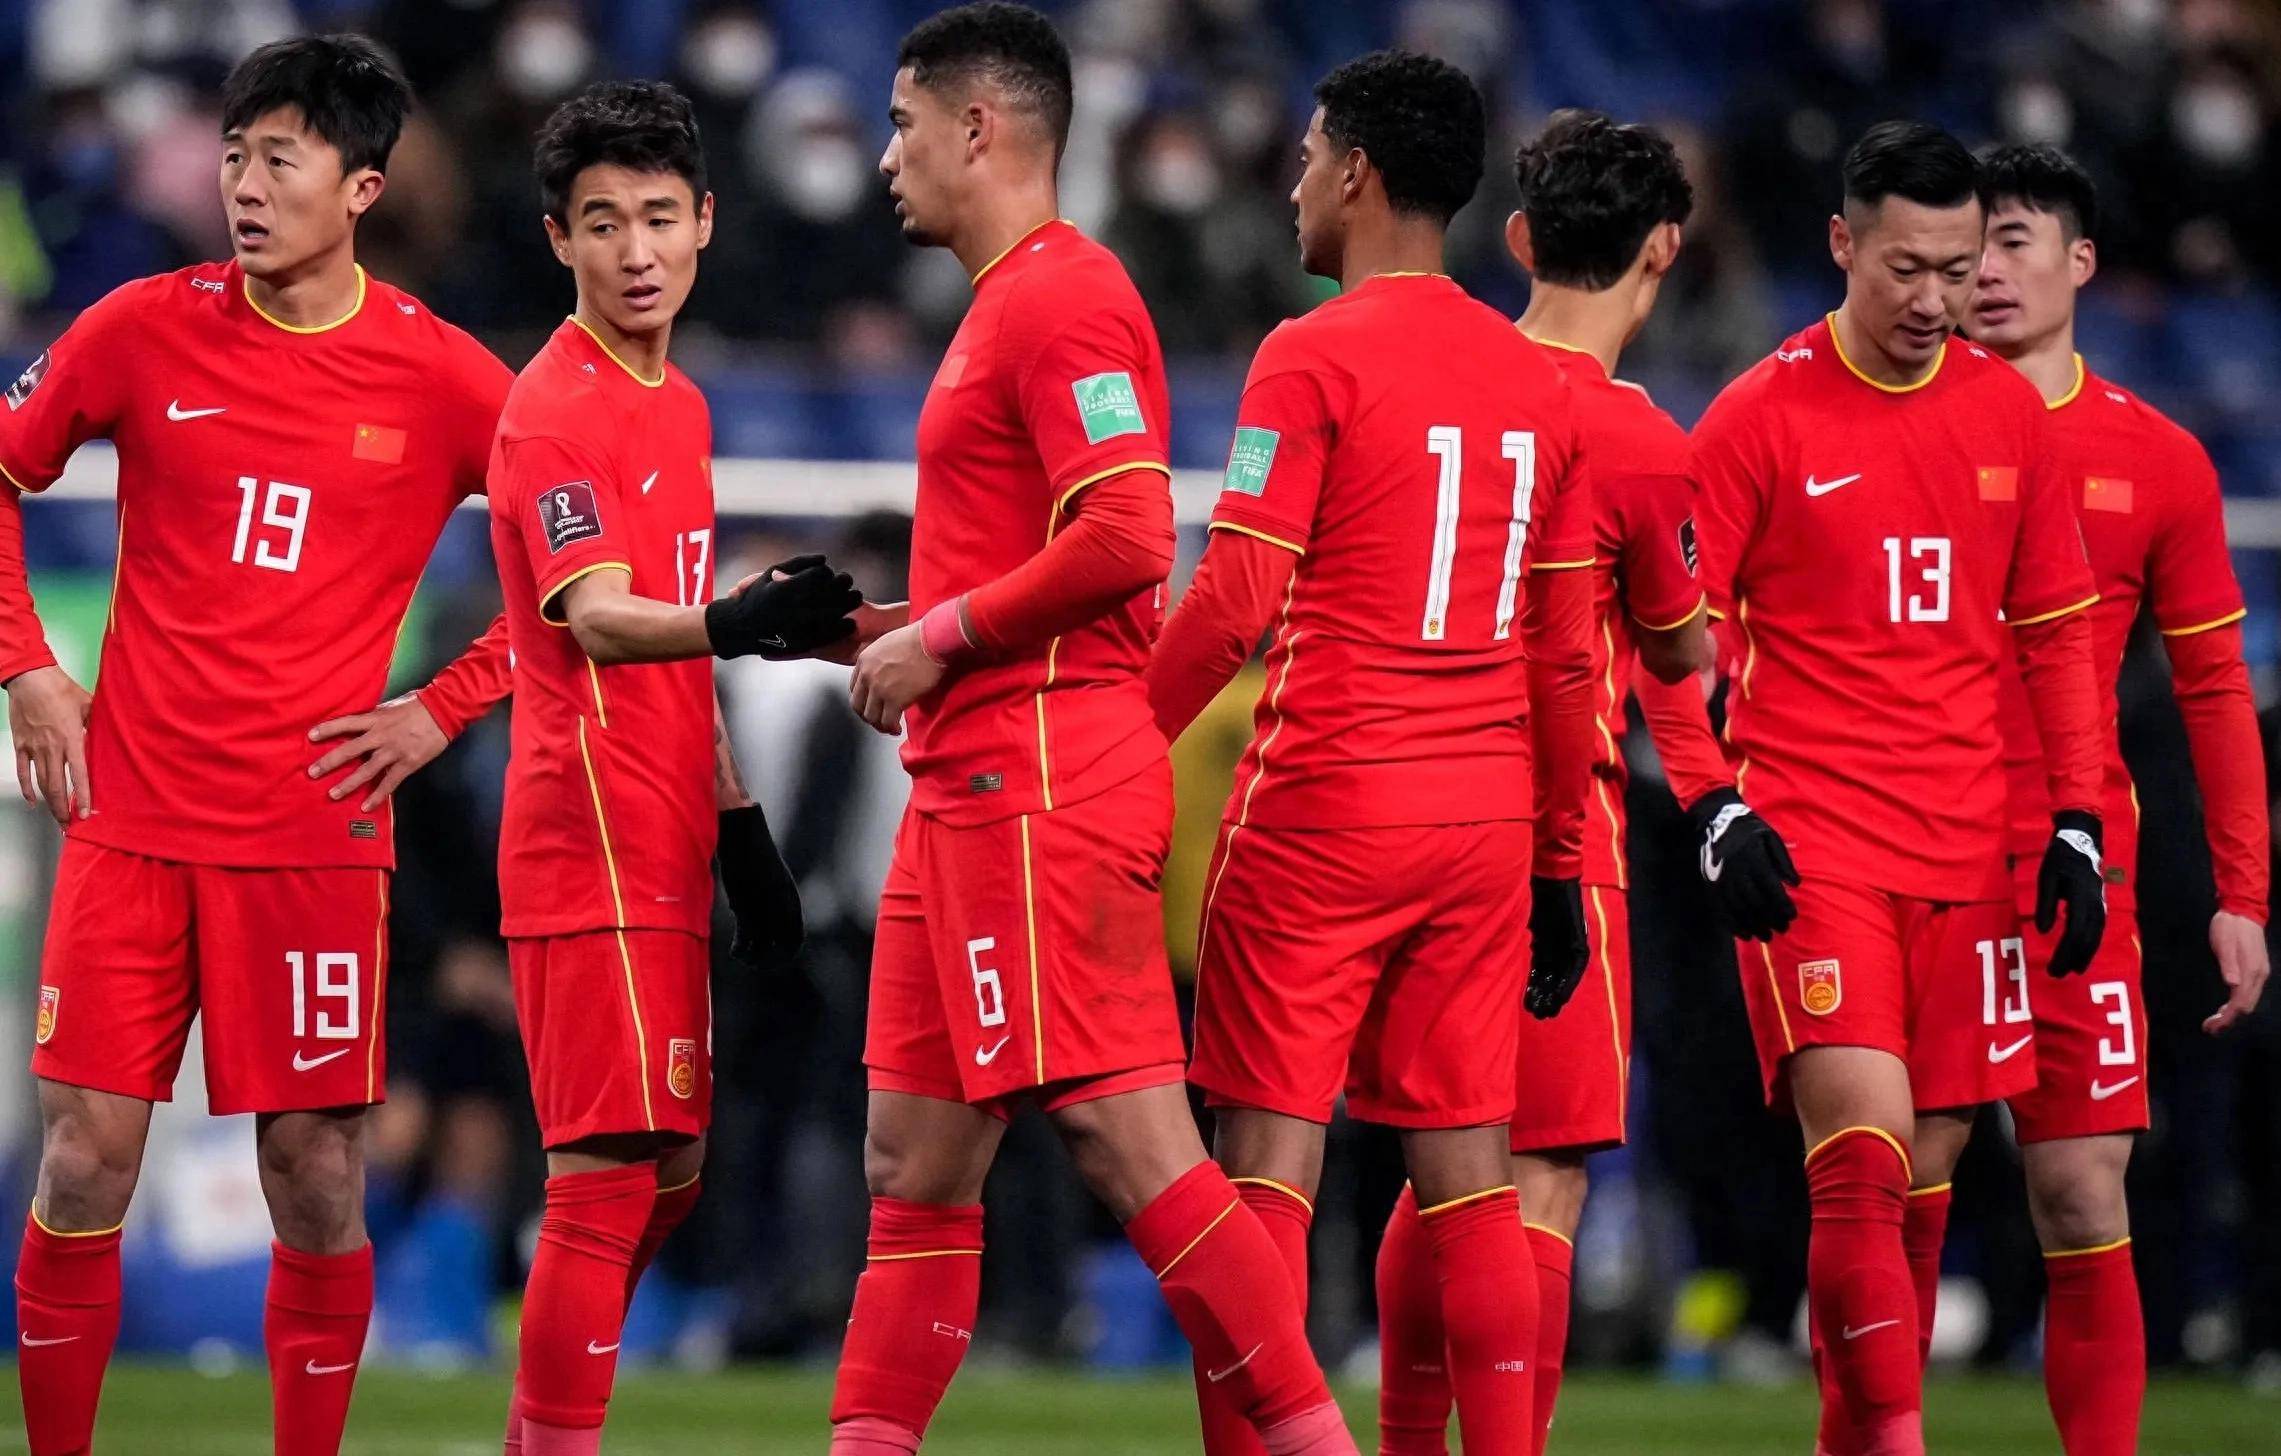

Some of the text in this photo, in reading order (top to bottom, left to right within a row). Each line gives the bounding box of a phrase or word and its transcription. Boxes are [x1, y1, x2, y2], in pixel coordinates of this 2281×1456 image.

[190, 277, 225, 294] CFA
[232, 476, 312, 573] 19
[1422, 426, 1536, 641] 11
[676, 528, 711, 609] 17
[1883, 537, 1951, 623] 13
[286, 951, 360, 1039] 19
[967, 936, 1006, 1027] 6
[1975, 938, 2033, 1025] 13
[2090, 981, 2136, 1066] 3
[1495, 1361, 1524, 1372] 中国
